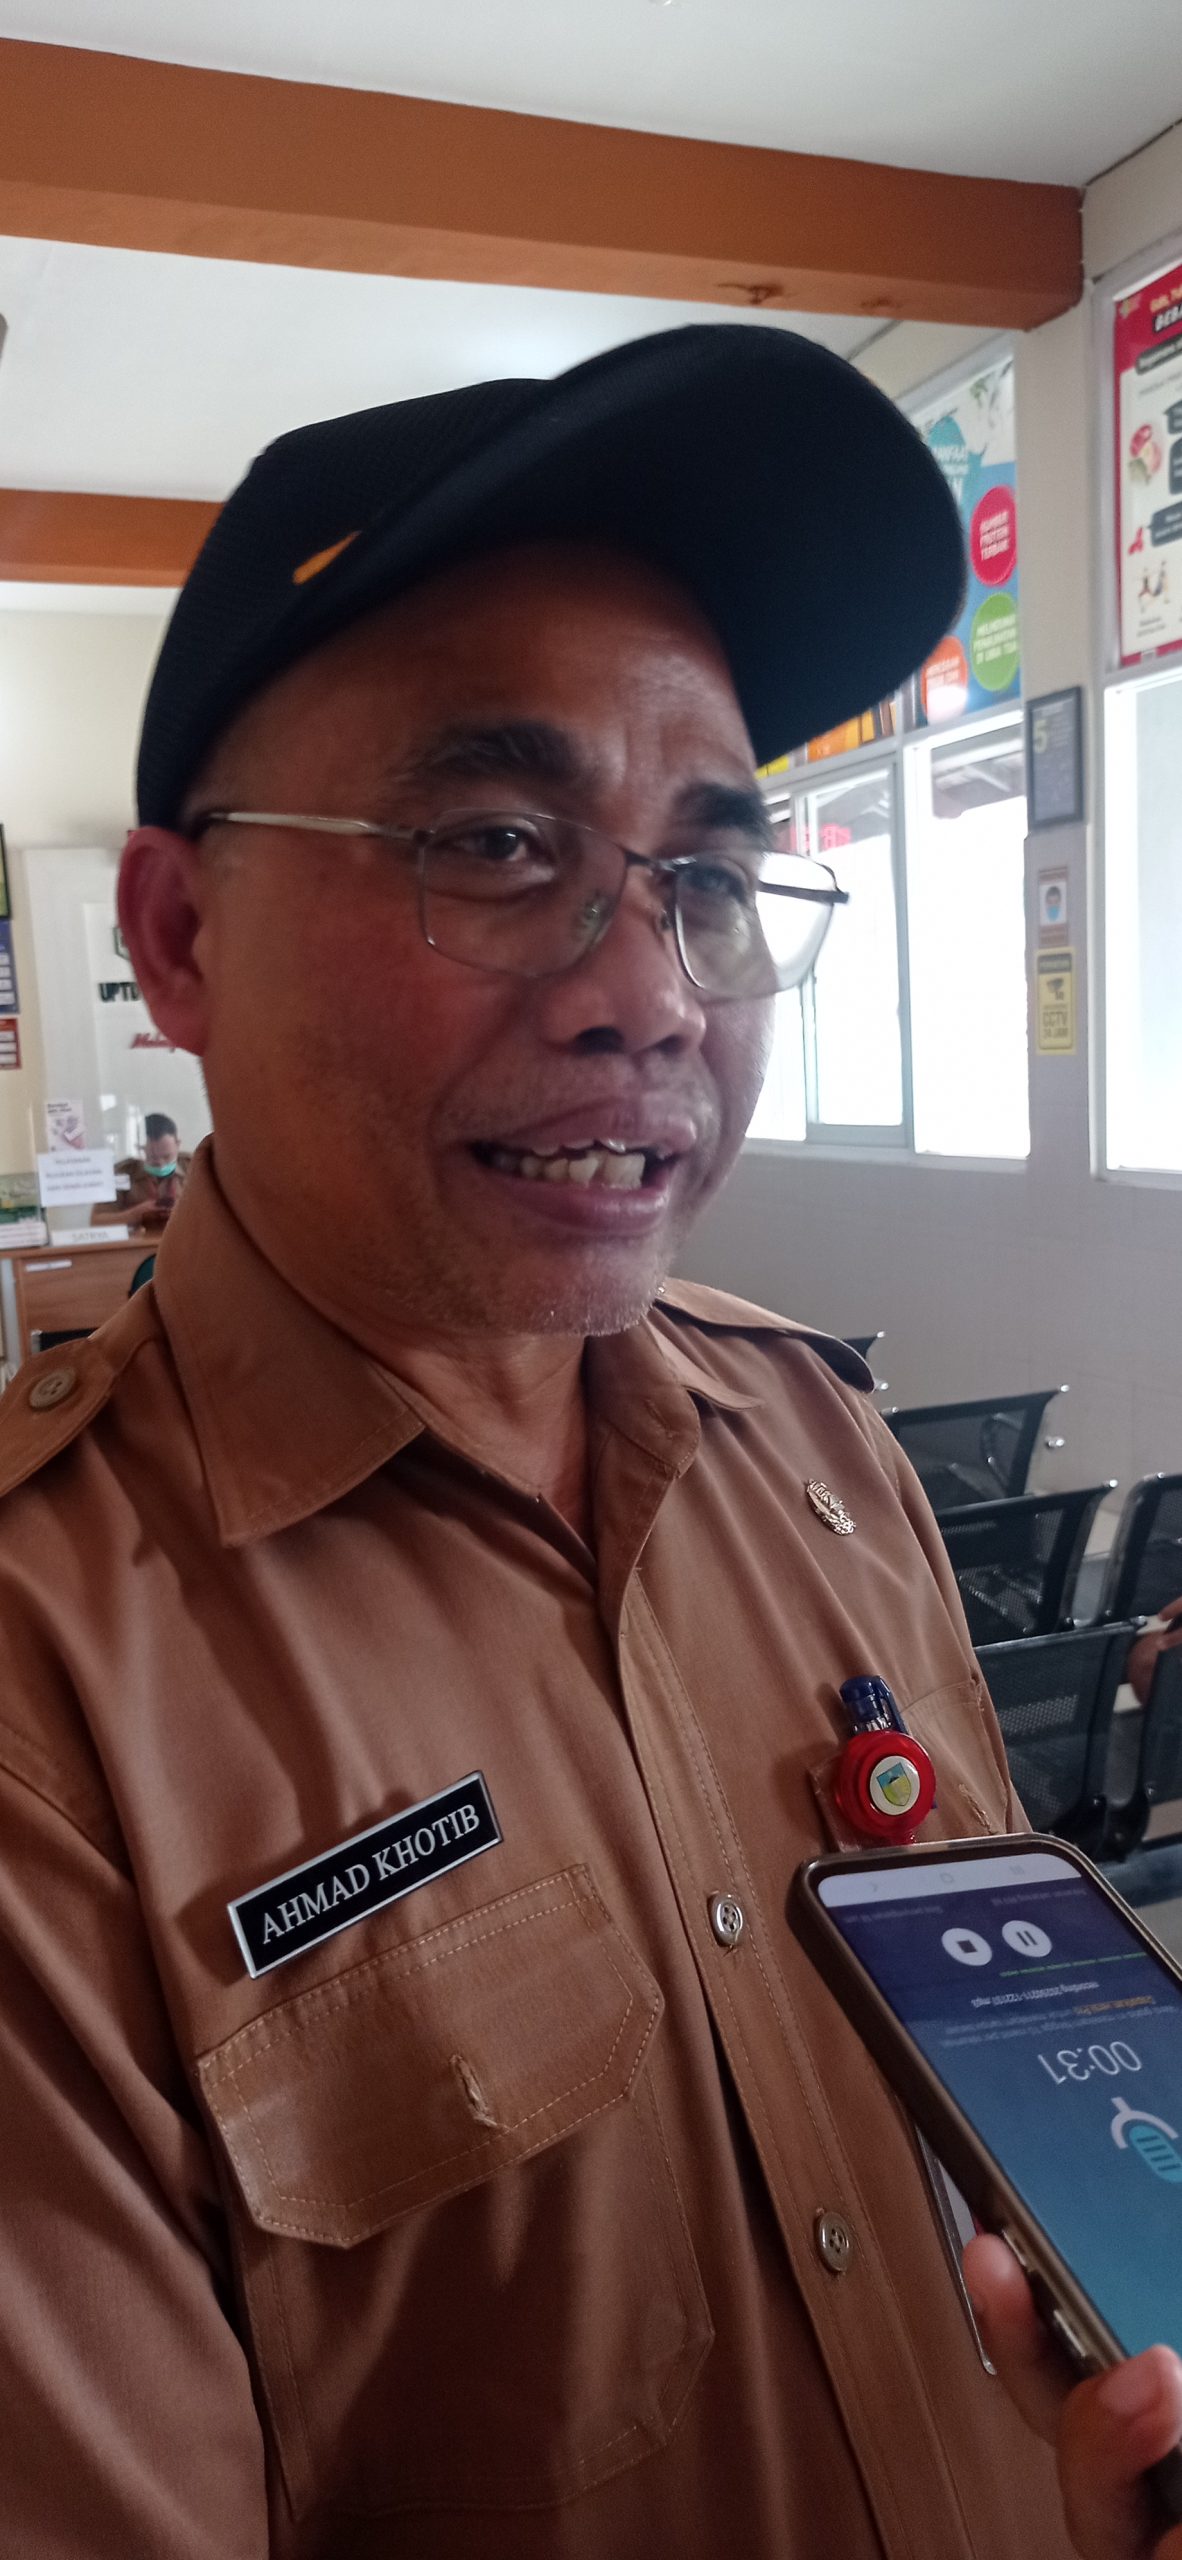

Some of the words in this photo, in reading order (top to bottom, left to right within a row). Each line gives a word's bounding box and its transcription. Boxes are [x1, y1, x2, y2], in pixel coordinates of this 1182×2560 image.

[1042, 1010, 1067, 1026] CCTV
[262, 1864, 370, 1945] AHMAD
[372, 1804, 480, 1881] KHOTIB
[1038, 2041, 1142, 2084] 00:31
